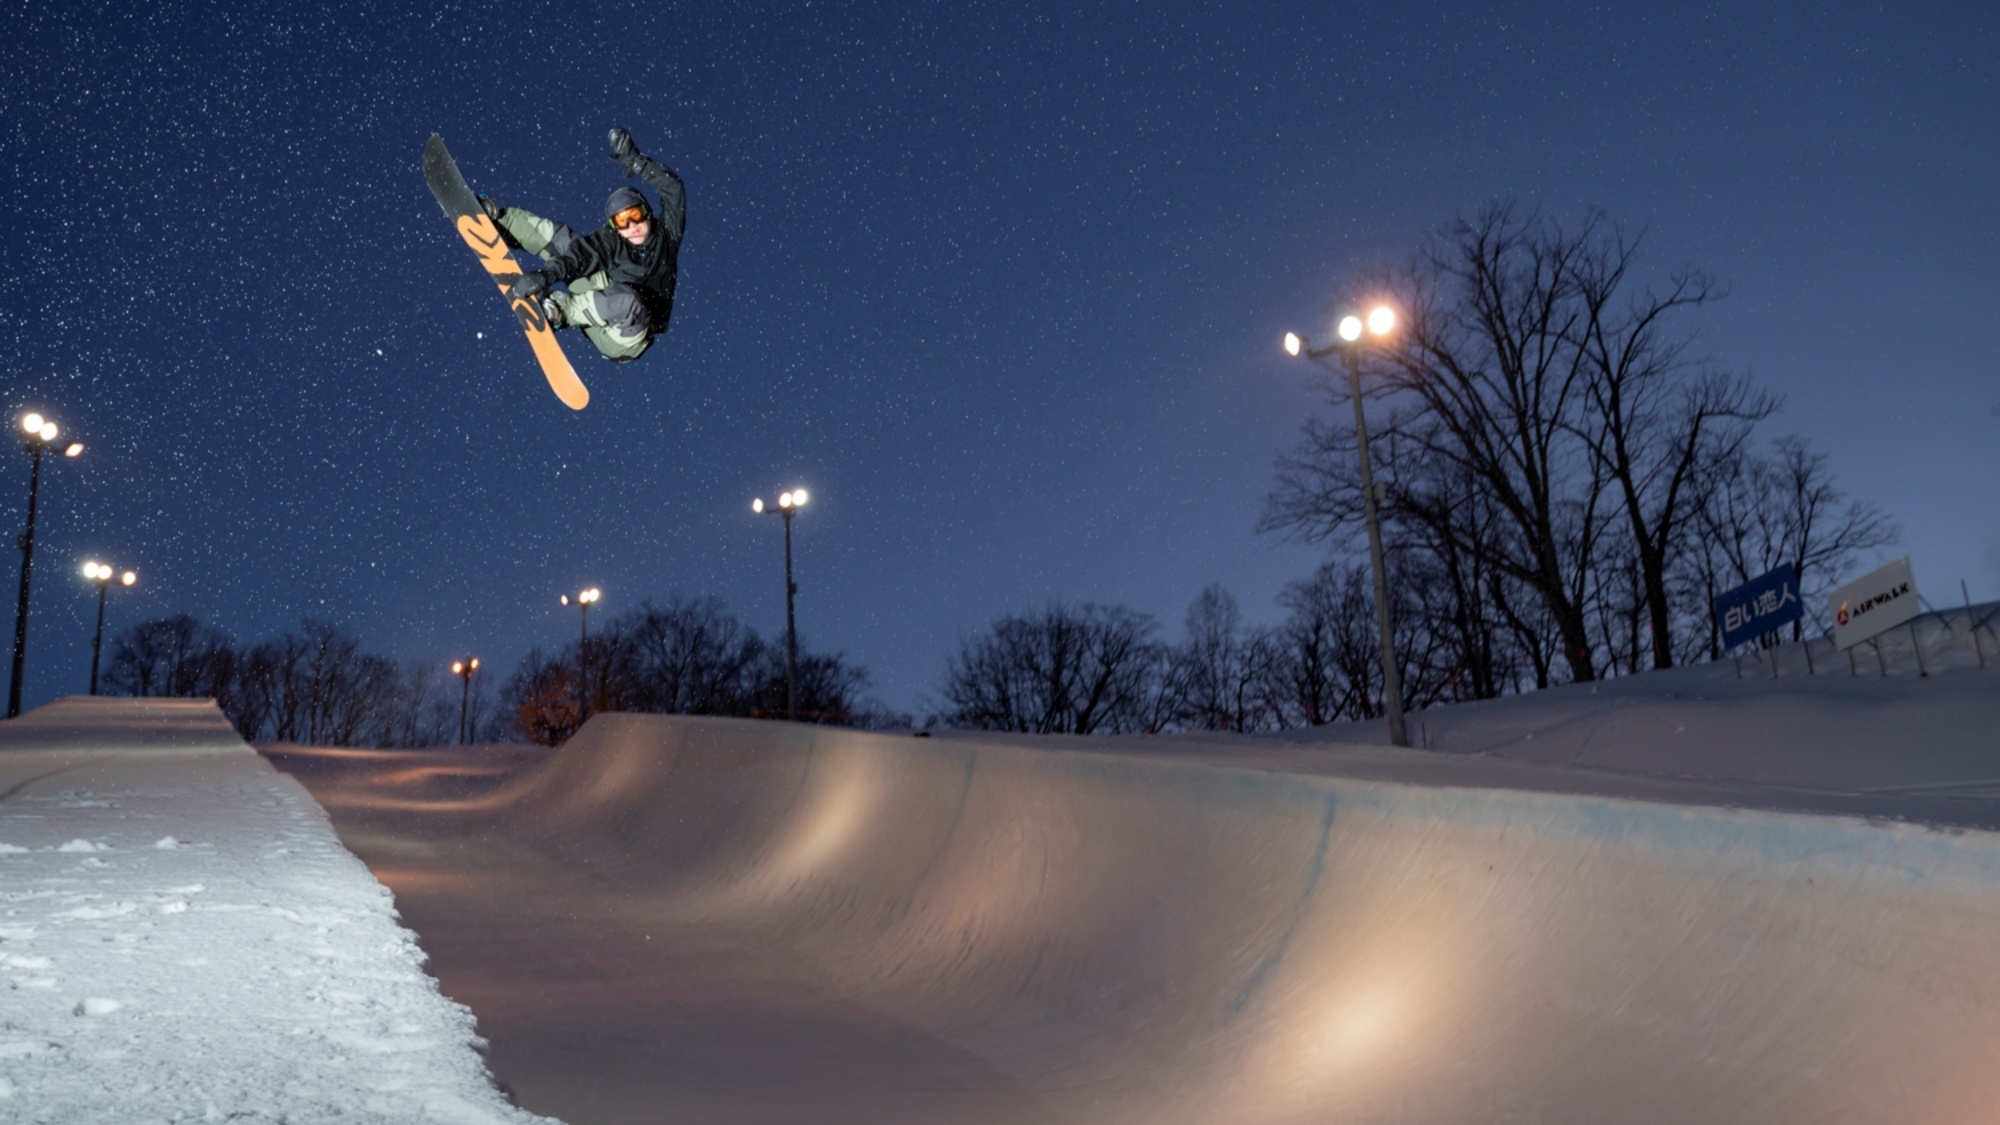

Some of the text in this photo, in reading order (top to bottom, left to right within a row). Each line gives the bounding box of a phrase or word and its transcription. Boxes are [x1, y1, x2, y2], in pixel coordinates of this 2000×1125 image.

[1724, 582, 1796, 633] 白い恋人
[1852, 582, 1909, 618] AIRWALK
